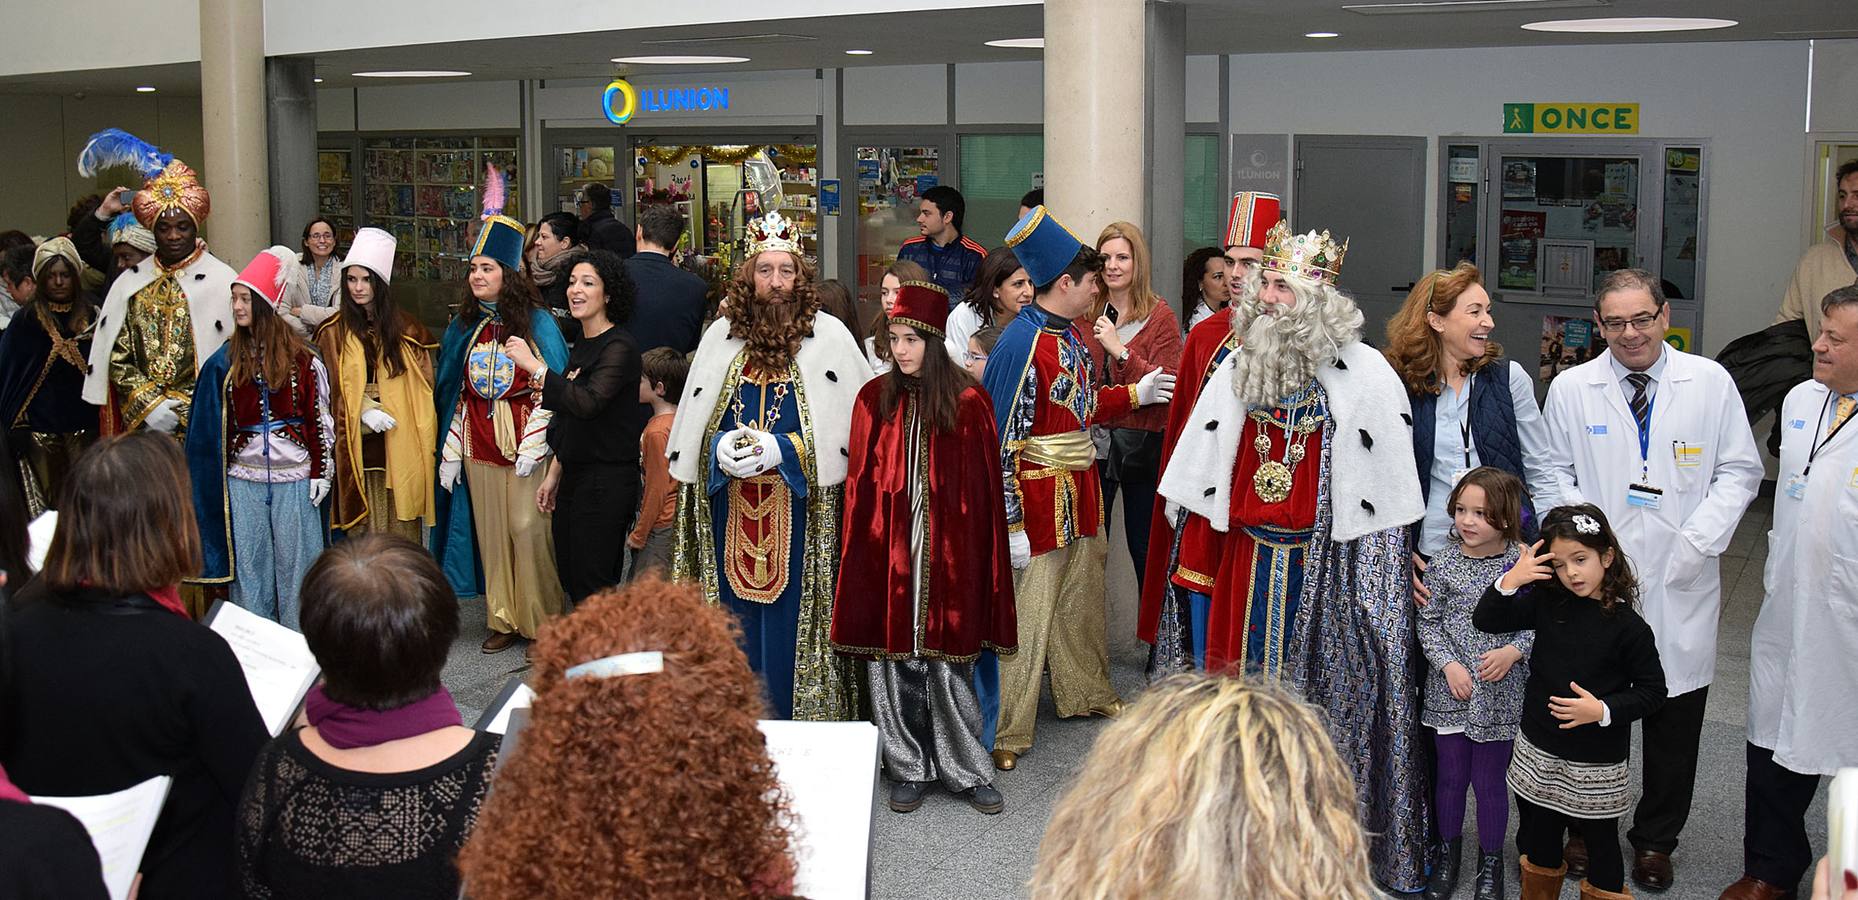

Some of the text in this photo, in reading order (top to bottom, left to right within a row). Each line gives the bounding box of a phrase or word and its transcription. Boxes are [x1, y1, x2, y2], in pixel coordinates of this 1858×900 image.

[641, 87, 729, 112] ILUNION
[1541, 107, 1632, 129] ONCE
[1238, 169, 1280, 179] ILUNION
